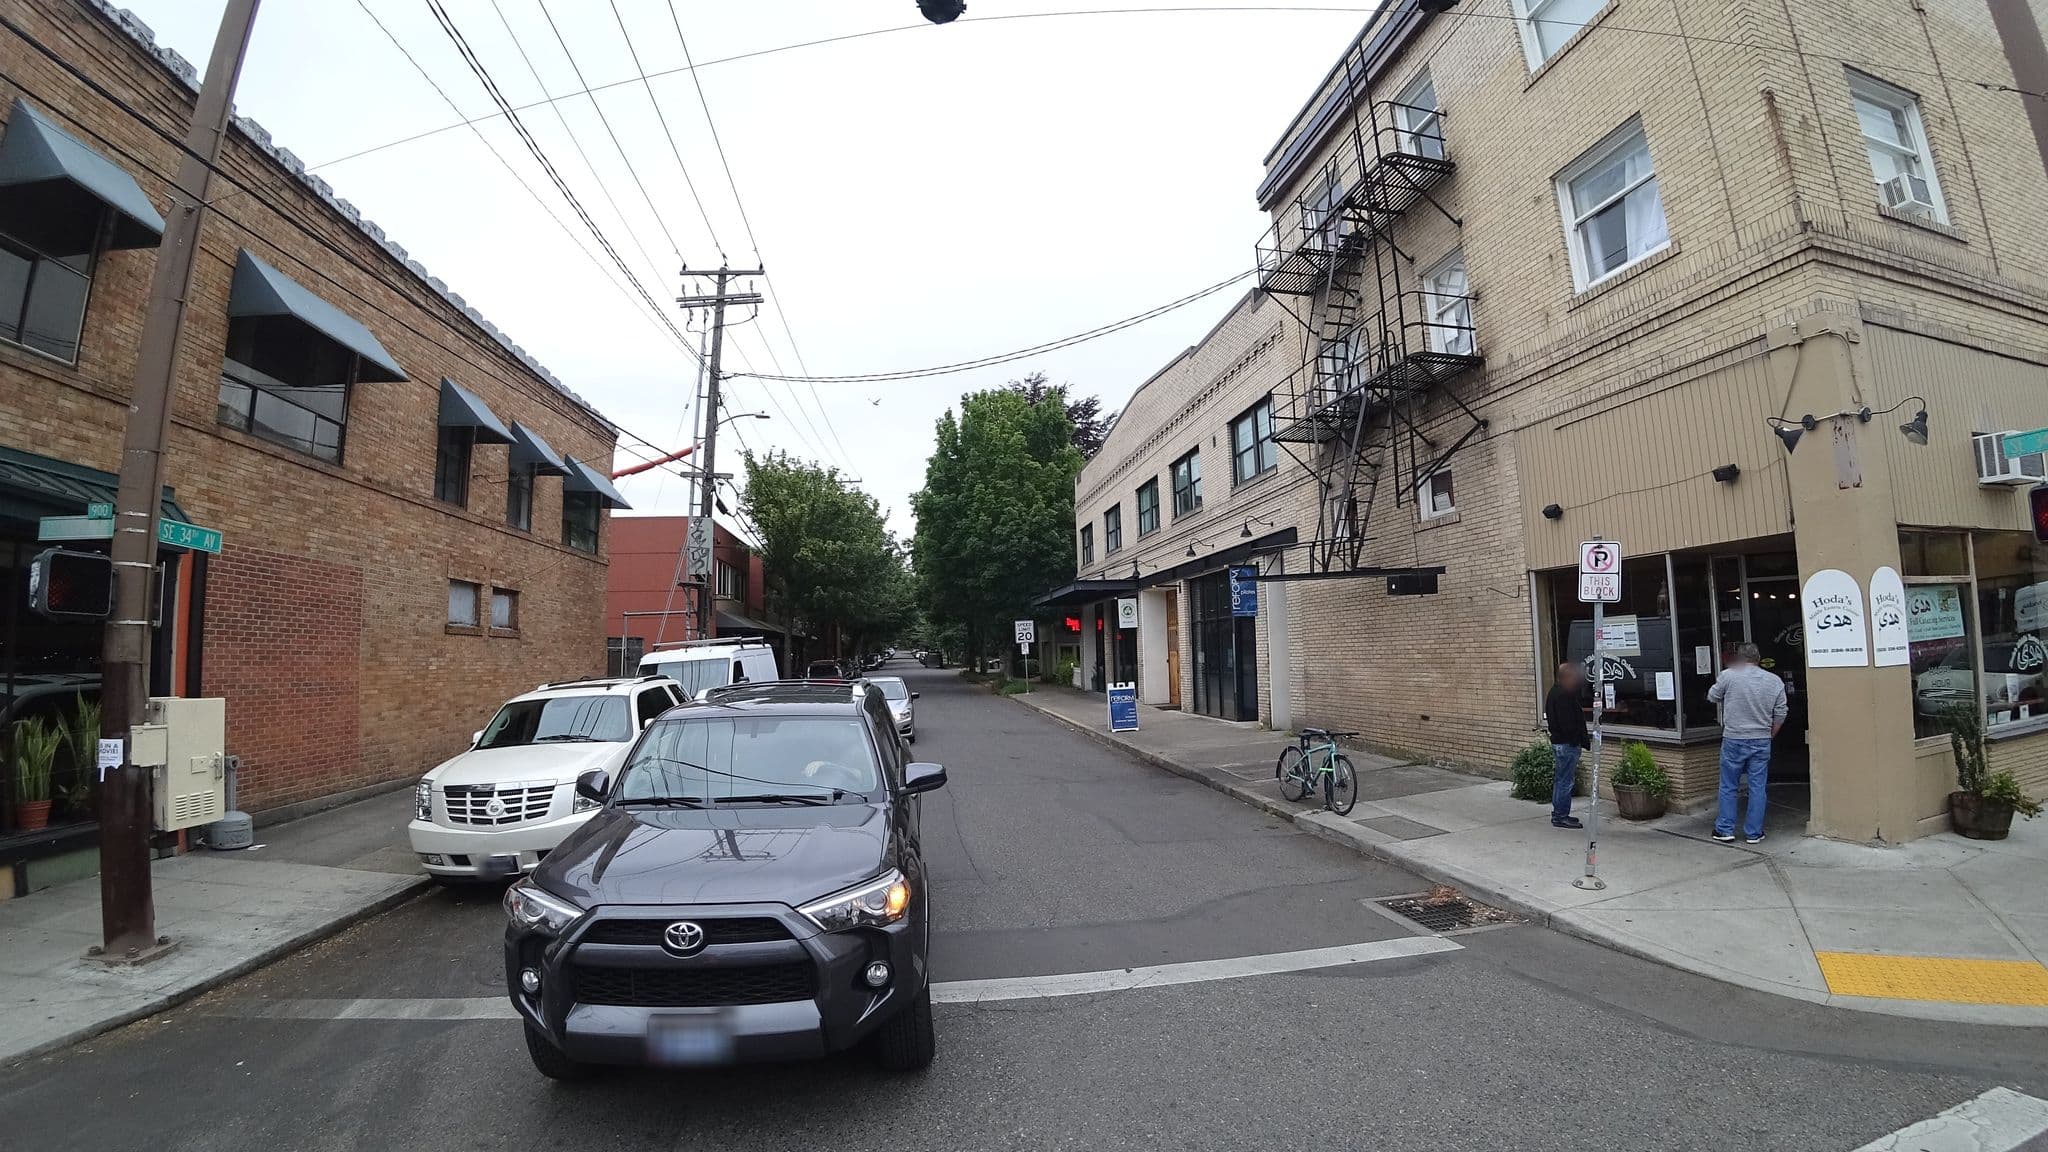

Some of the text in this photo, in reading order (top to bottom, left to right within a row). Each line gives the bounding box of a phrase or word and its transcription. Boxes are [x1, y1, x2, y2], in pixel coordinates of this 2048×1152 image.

[92, 504, 107, 517] 900
[162, 525, 174, 540] SE
[204, 535, 216, 549] AV
[1589, 576, 1610, 586] THIS
[1584, 587, 1615, 597] BLOCK
[1812, 594, 1853, 608] Hoda's
[1017, 632, 1032, 641] 20
